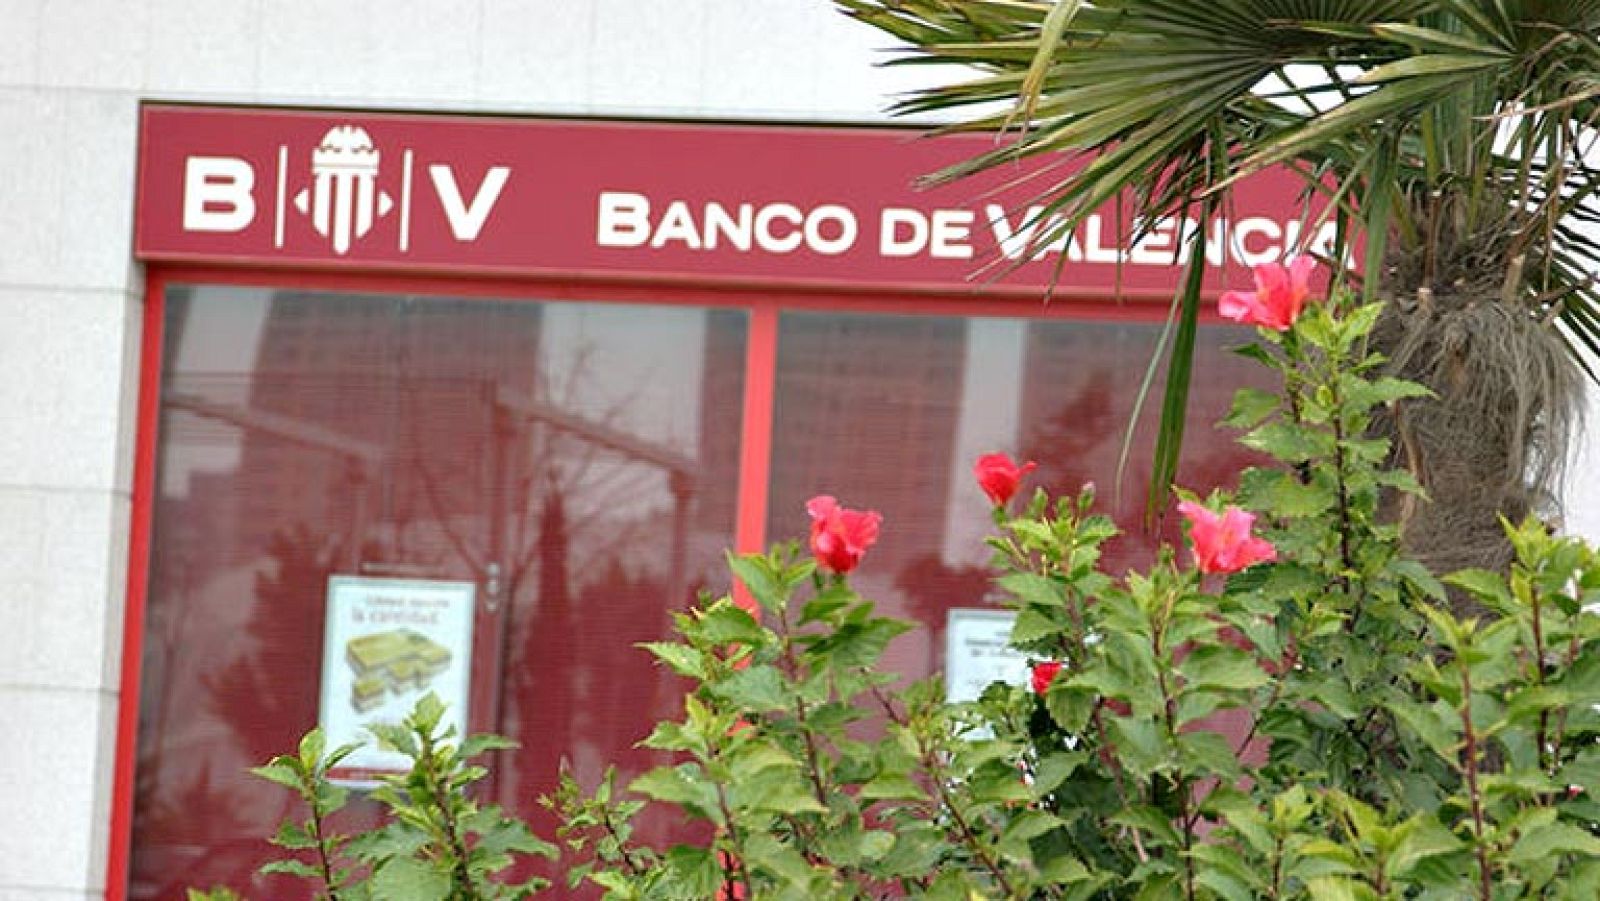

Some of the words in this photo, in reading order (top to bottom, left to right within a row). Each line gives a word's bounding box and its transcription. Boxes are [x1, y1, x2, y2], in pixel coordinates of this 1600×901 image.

[183, 156, 256, 232] B
[428, 164, 511, 241] V
[597, 191, 858, 255] BANCO
[879, 207, 974, 259] DE
